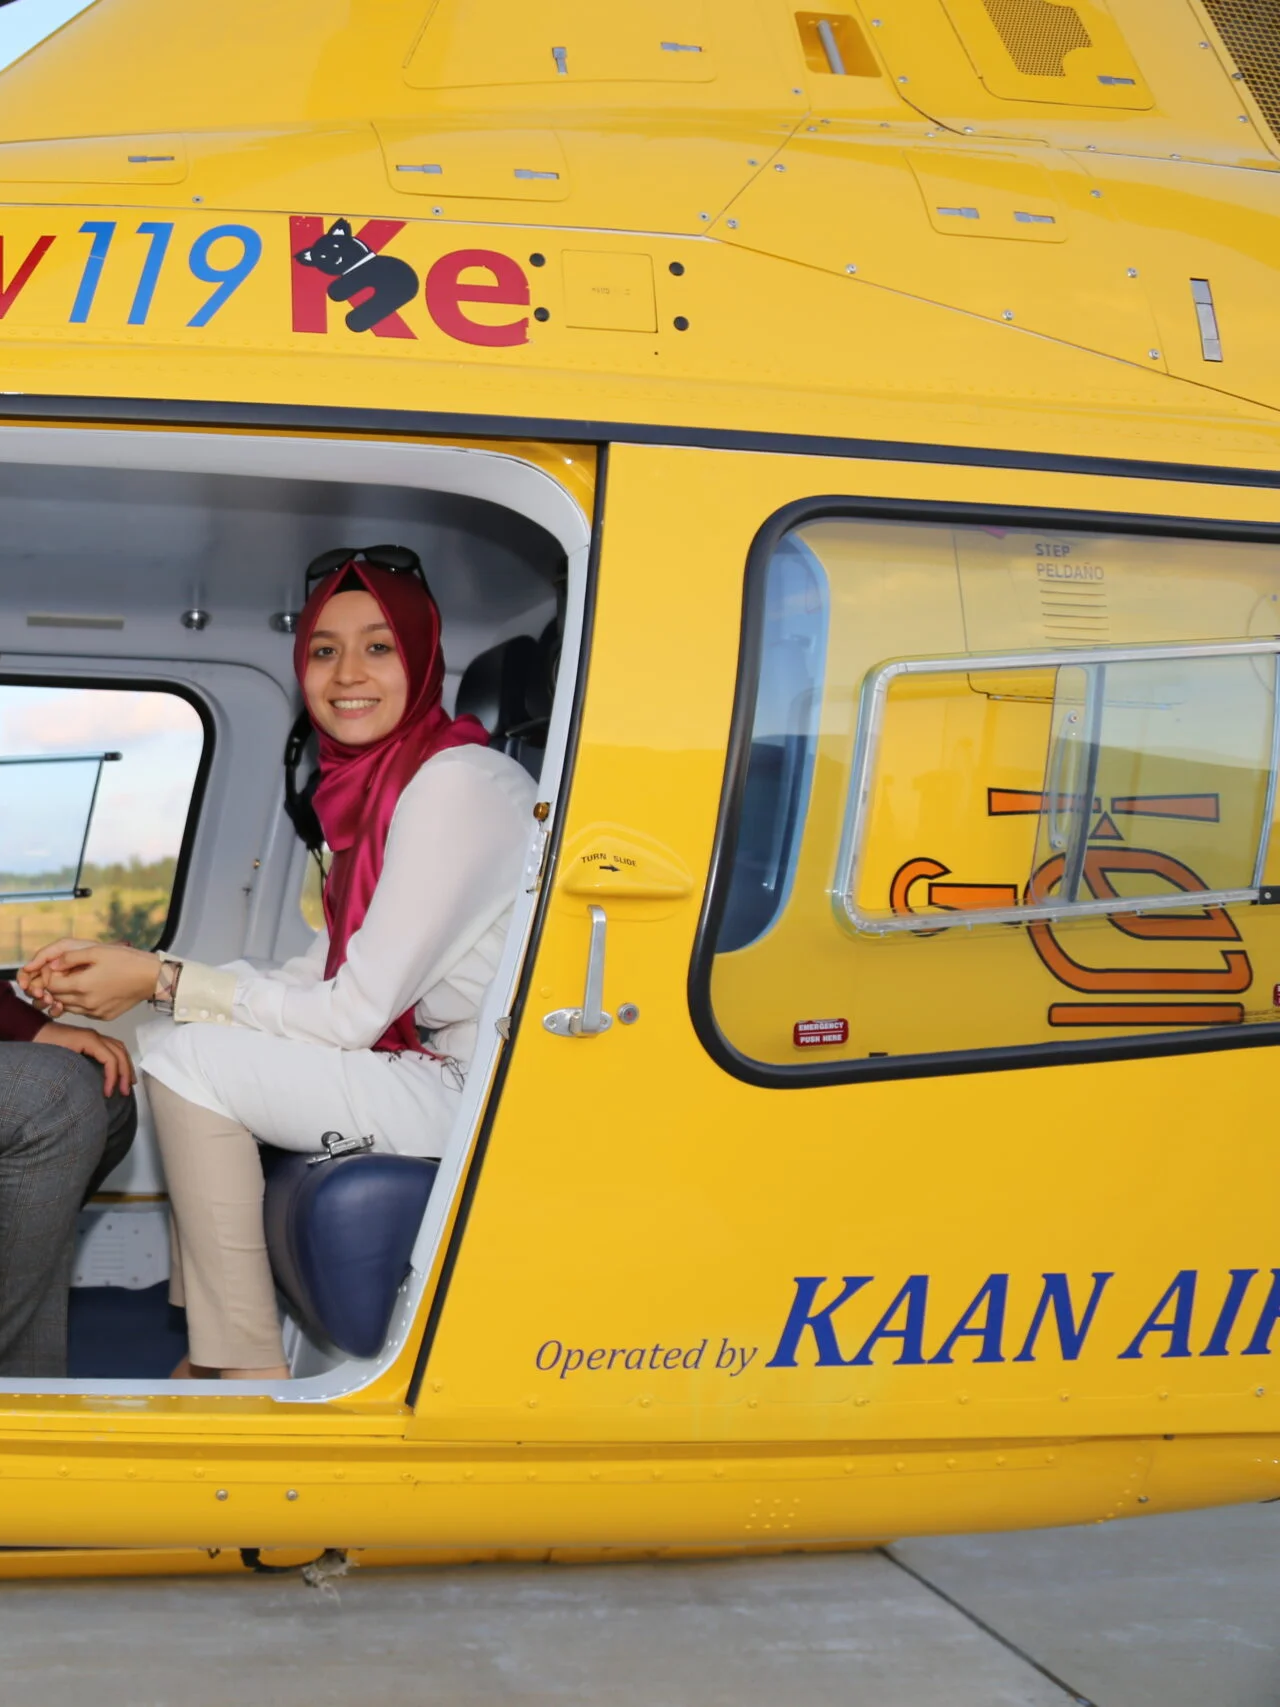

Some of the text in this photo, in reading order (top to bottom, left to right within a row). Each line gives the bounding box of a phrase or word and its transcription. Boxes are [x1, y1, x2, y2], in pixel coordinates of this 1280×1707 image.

[1035, 543, 1070, 557] STEP
[1036, 561, 1105, 580] PELDAÑO
[581, 852, 637, 867] TURN SLIDE
[798, 1021, 845, 1031] EMERGENCY
[800, 1035, 821, 1043] PUSH
[535, 1339, 709, 1379] Operated
[715, 1337, 759, 1376] by
[765, 1271, 1115, 1368] KAAN
